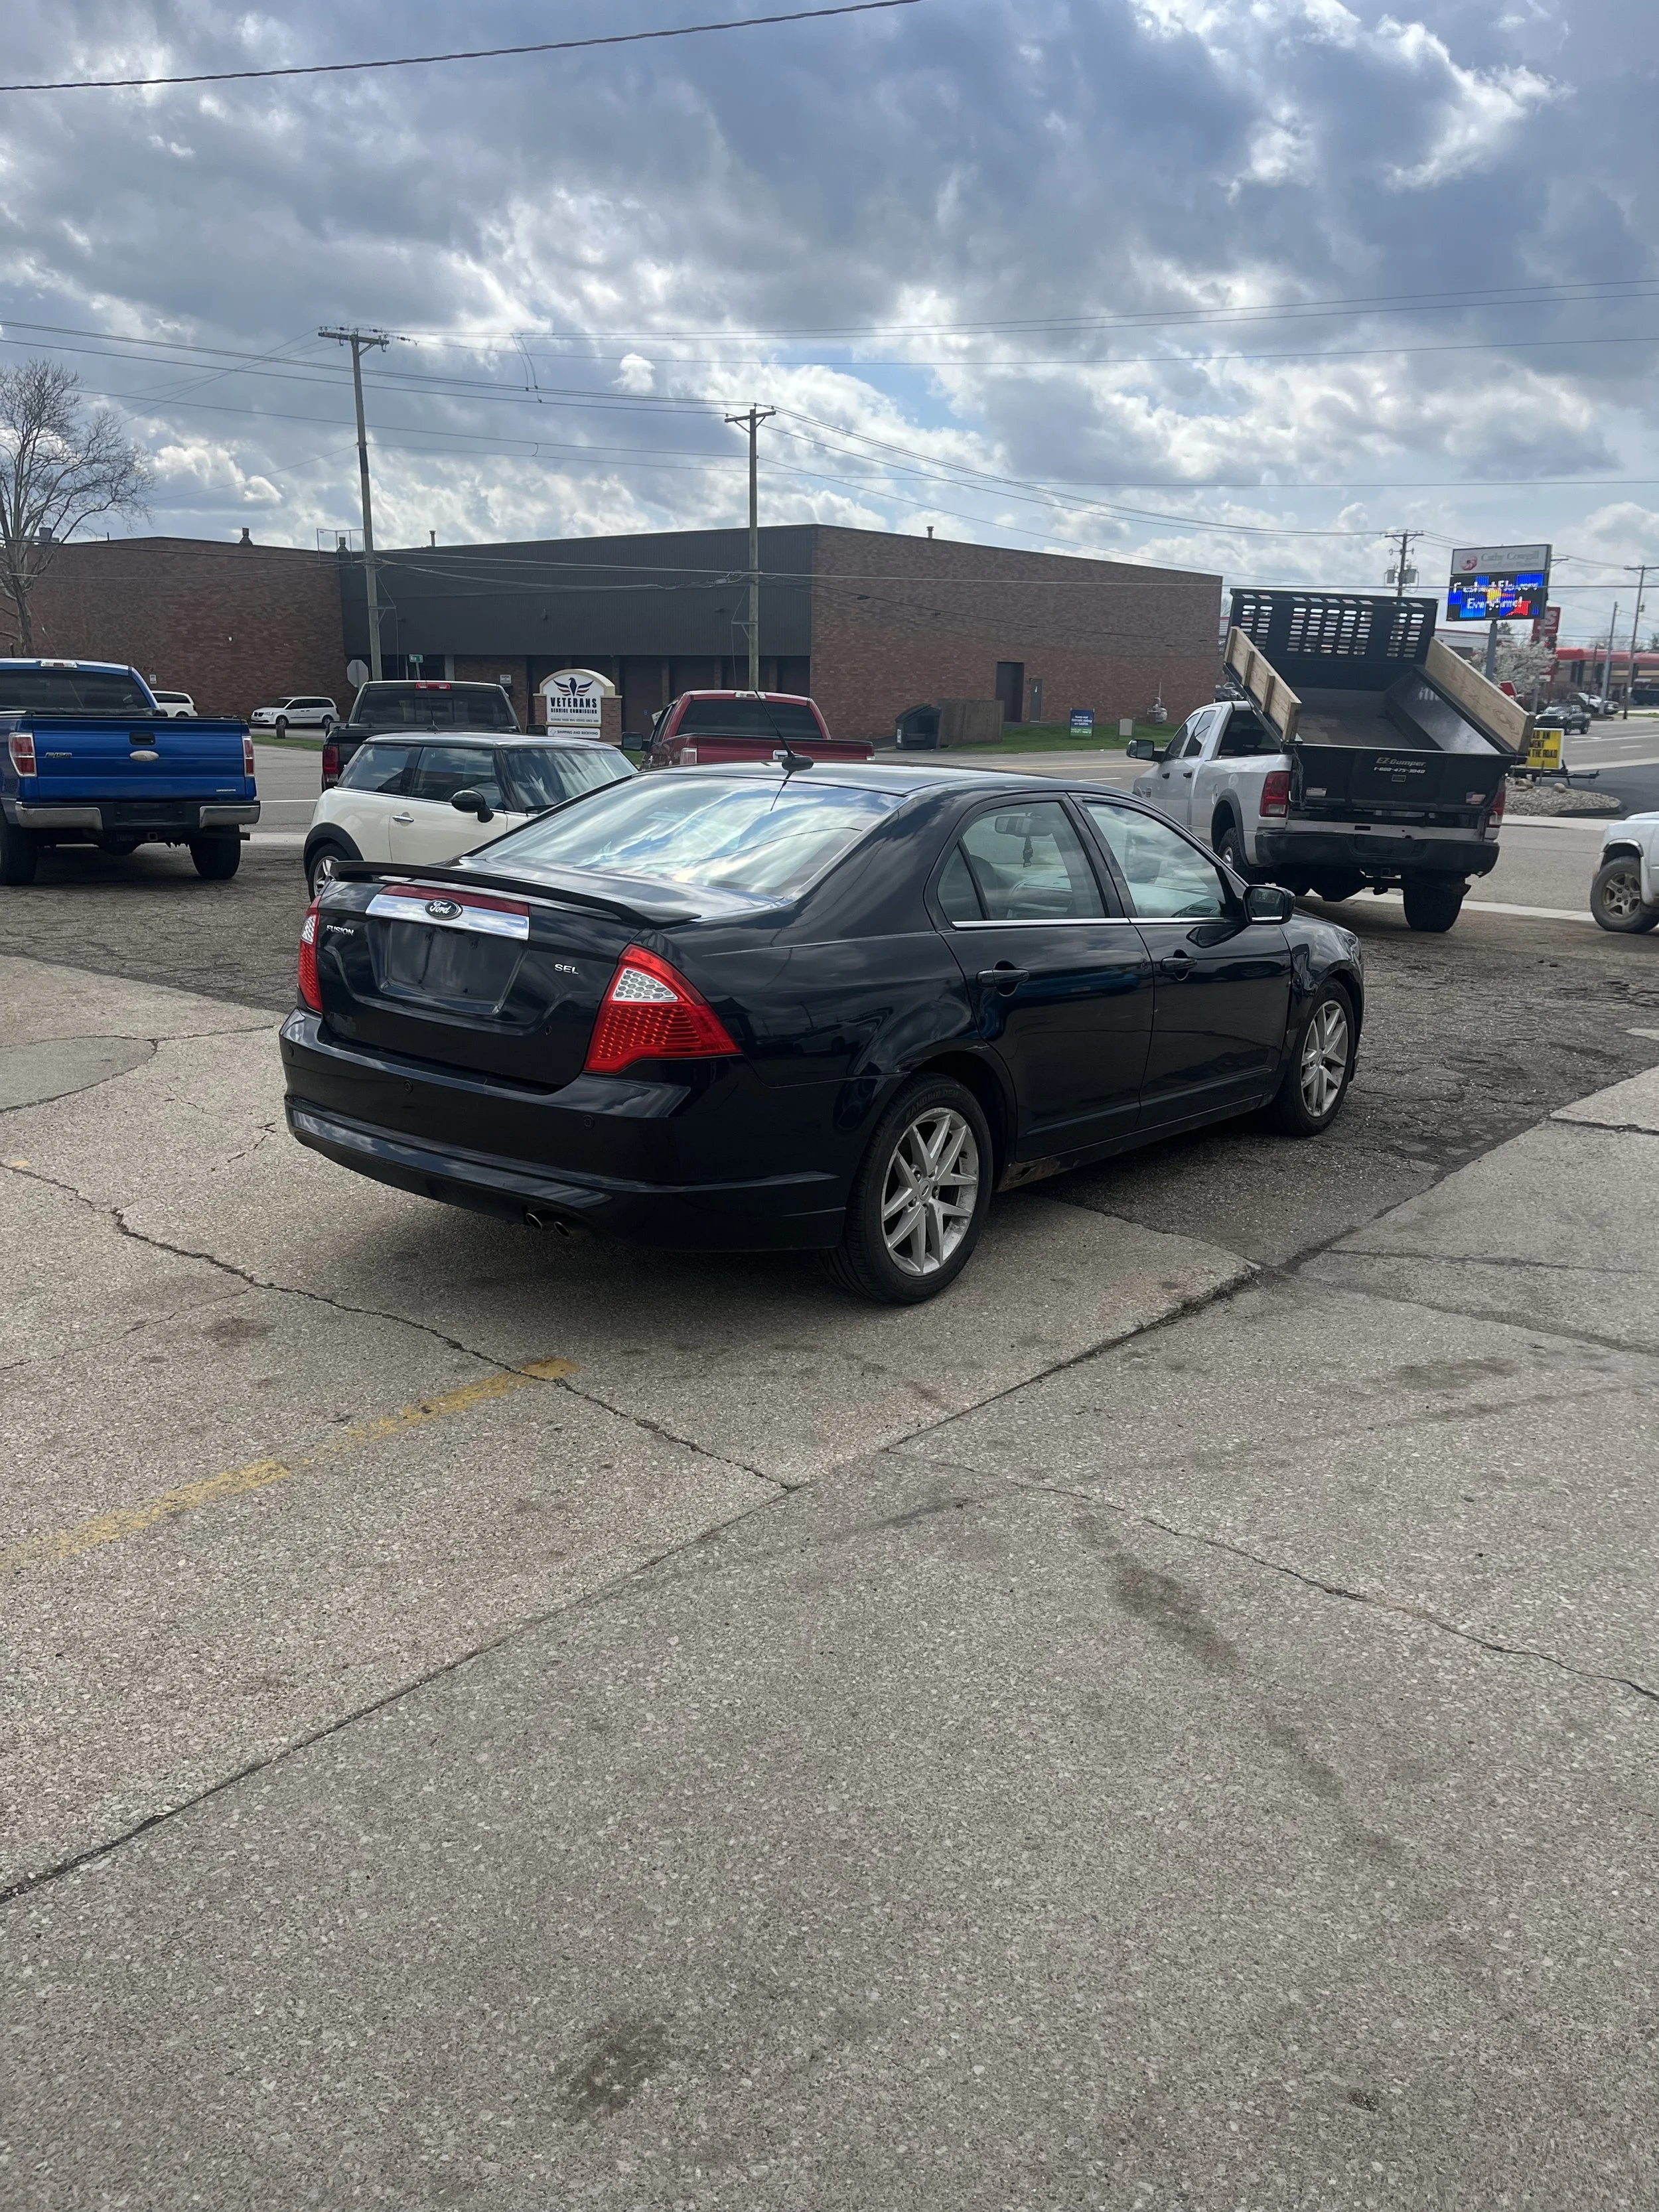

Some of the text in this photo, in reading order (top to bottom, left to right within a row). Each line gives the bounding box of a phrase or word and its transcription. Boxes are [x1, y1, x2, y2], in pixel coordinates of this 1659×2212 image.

[550, 698, 597, 708] VETERANS
[429, 901, 452, 914] Ford
[326, 924, 354, 936] FUSION
[553, 963, 580, 976] SEL
